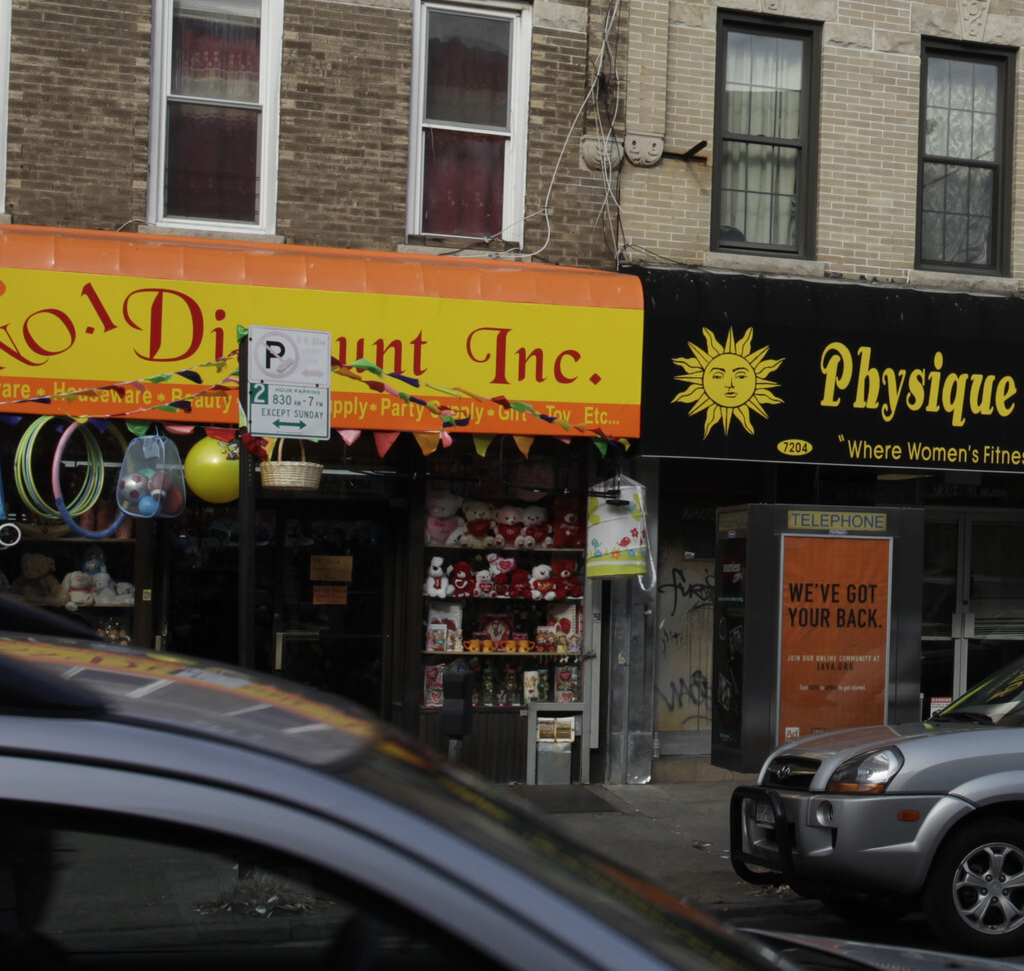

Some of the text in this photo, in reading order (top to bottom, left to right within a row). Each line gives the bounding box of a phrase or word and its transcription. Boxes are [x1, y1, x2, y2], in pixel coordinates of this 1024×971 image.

[122, 287, 428, 377] Diunt
[466, 327, 602, 385] Inc.
[0, 382, 31, 398] are
[254, 383, 266, 404] 2
[820, 341, 1018, 427] Physique
[272, 394, 292, 406] 830
[381, 398, 425, 422] Party
[261, 408, 324, 419] EXCEPT SUNDAY
[584, 406, 620, 425] Etc...
[783, 442, 808, 454] 7204
[907, 442, 979, 463] Women's
[791, 513, 884, 529] TELEPHONE
[789, 582, 878, 604] WE'VE GOT
[788, 606, 883, 629] YOUR BACK.
[787, 654, 881, 662] JOIN OUR ONLINE COMMUNITY AT
